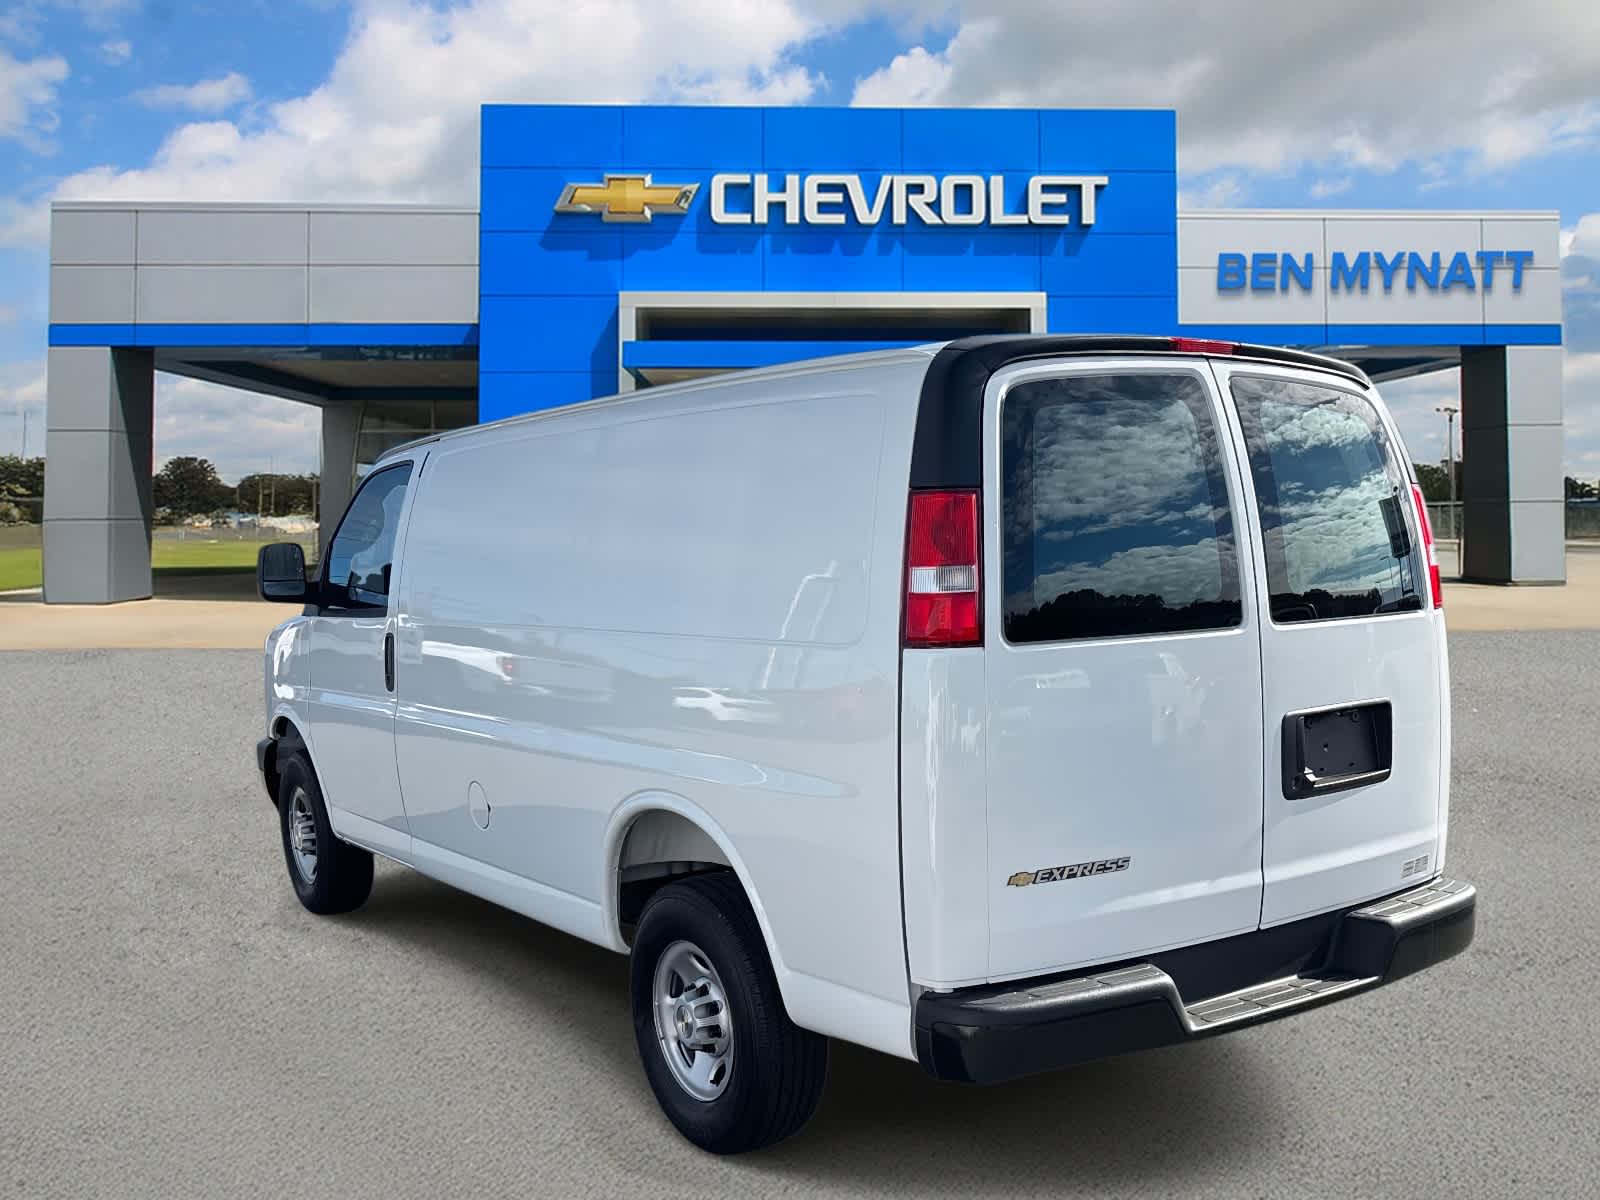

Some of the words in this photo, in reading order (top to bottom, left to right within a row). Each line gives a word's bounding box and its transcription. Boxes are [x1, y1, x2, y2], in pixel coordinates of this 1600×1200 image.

[710, 173, 1109, 226] CHEVROLET
[1217, 252, 1314, 291] BEN
[1330, 250, 1534, 291] MYNATT
[1032, 856, 1131, 884] EXPRESS
